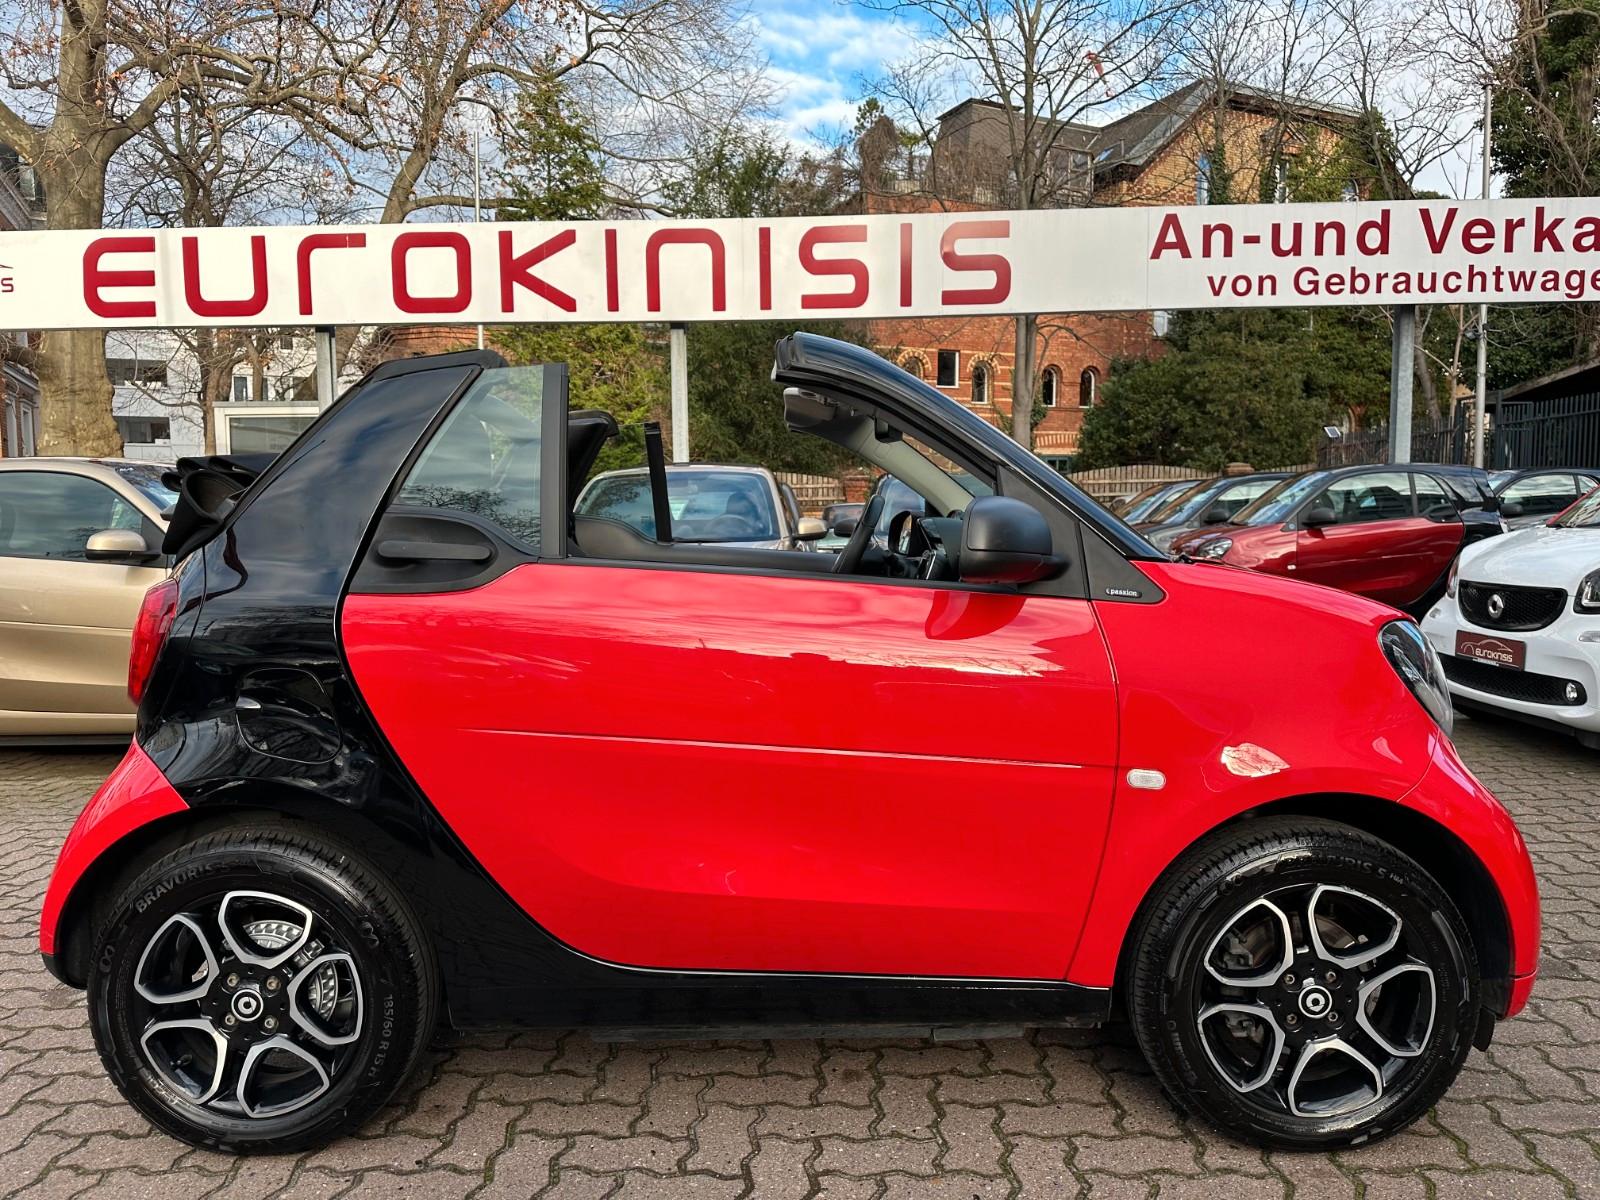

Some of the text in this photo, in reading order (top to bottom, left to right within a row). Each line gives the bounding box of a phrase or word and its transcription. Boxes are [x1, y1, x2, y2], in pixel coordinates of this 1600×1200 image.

[1150, 206, 1600, 260] An-und Verka
[1208, 273, 1278, 297] von
[1110, 588, 1137, 597] passion
[382, 994, 394, 1038] 185/60
[379, 1041, 390, 1050] R
